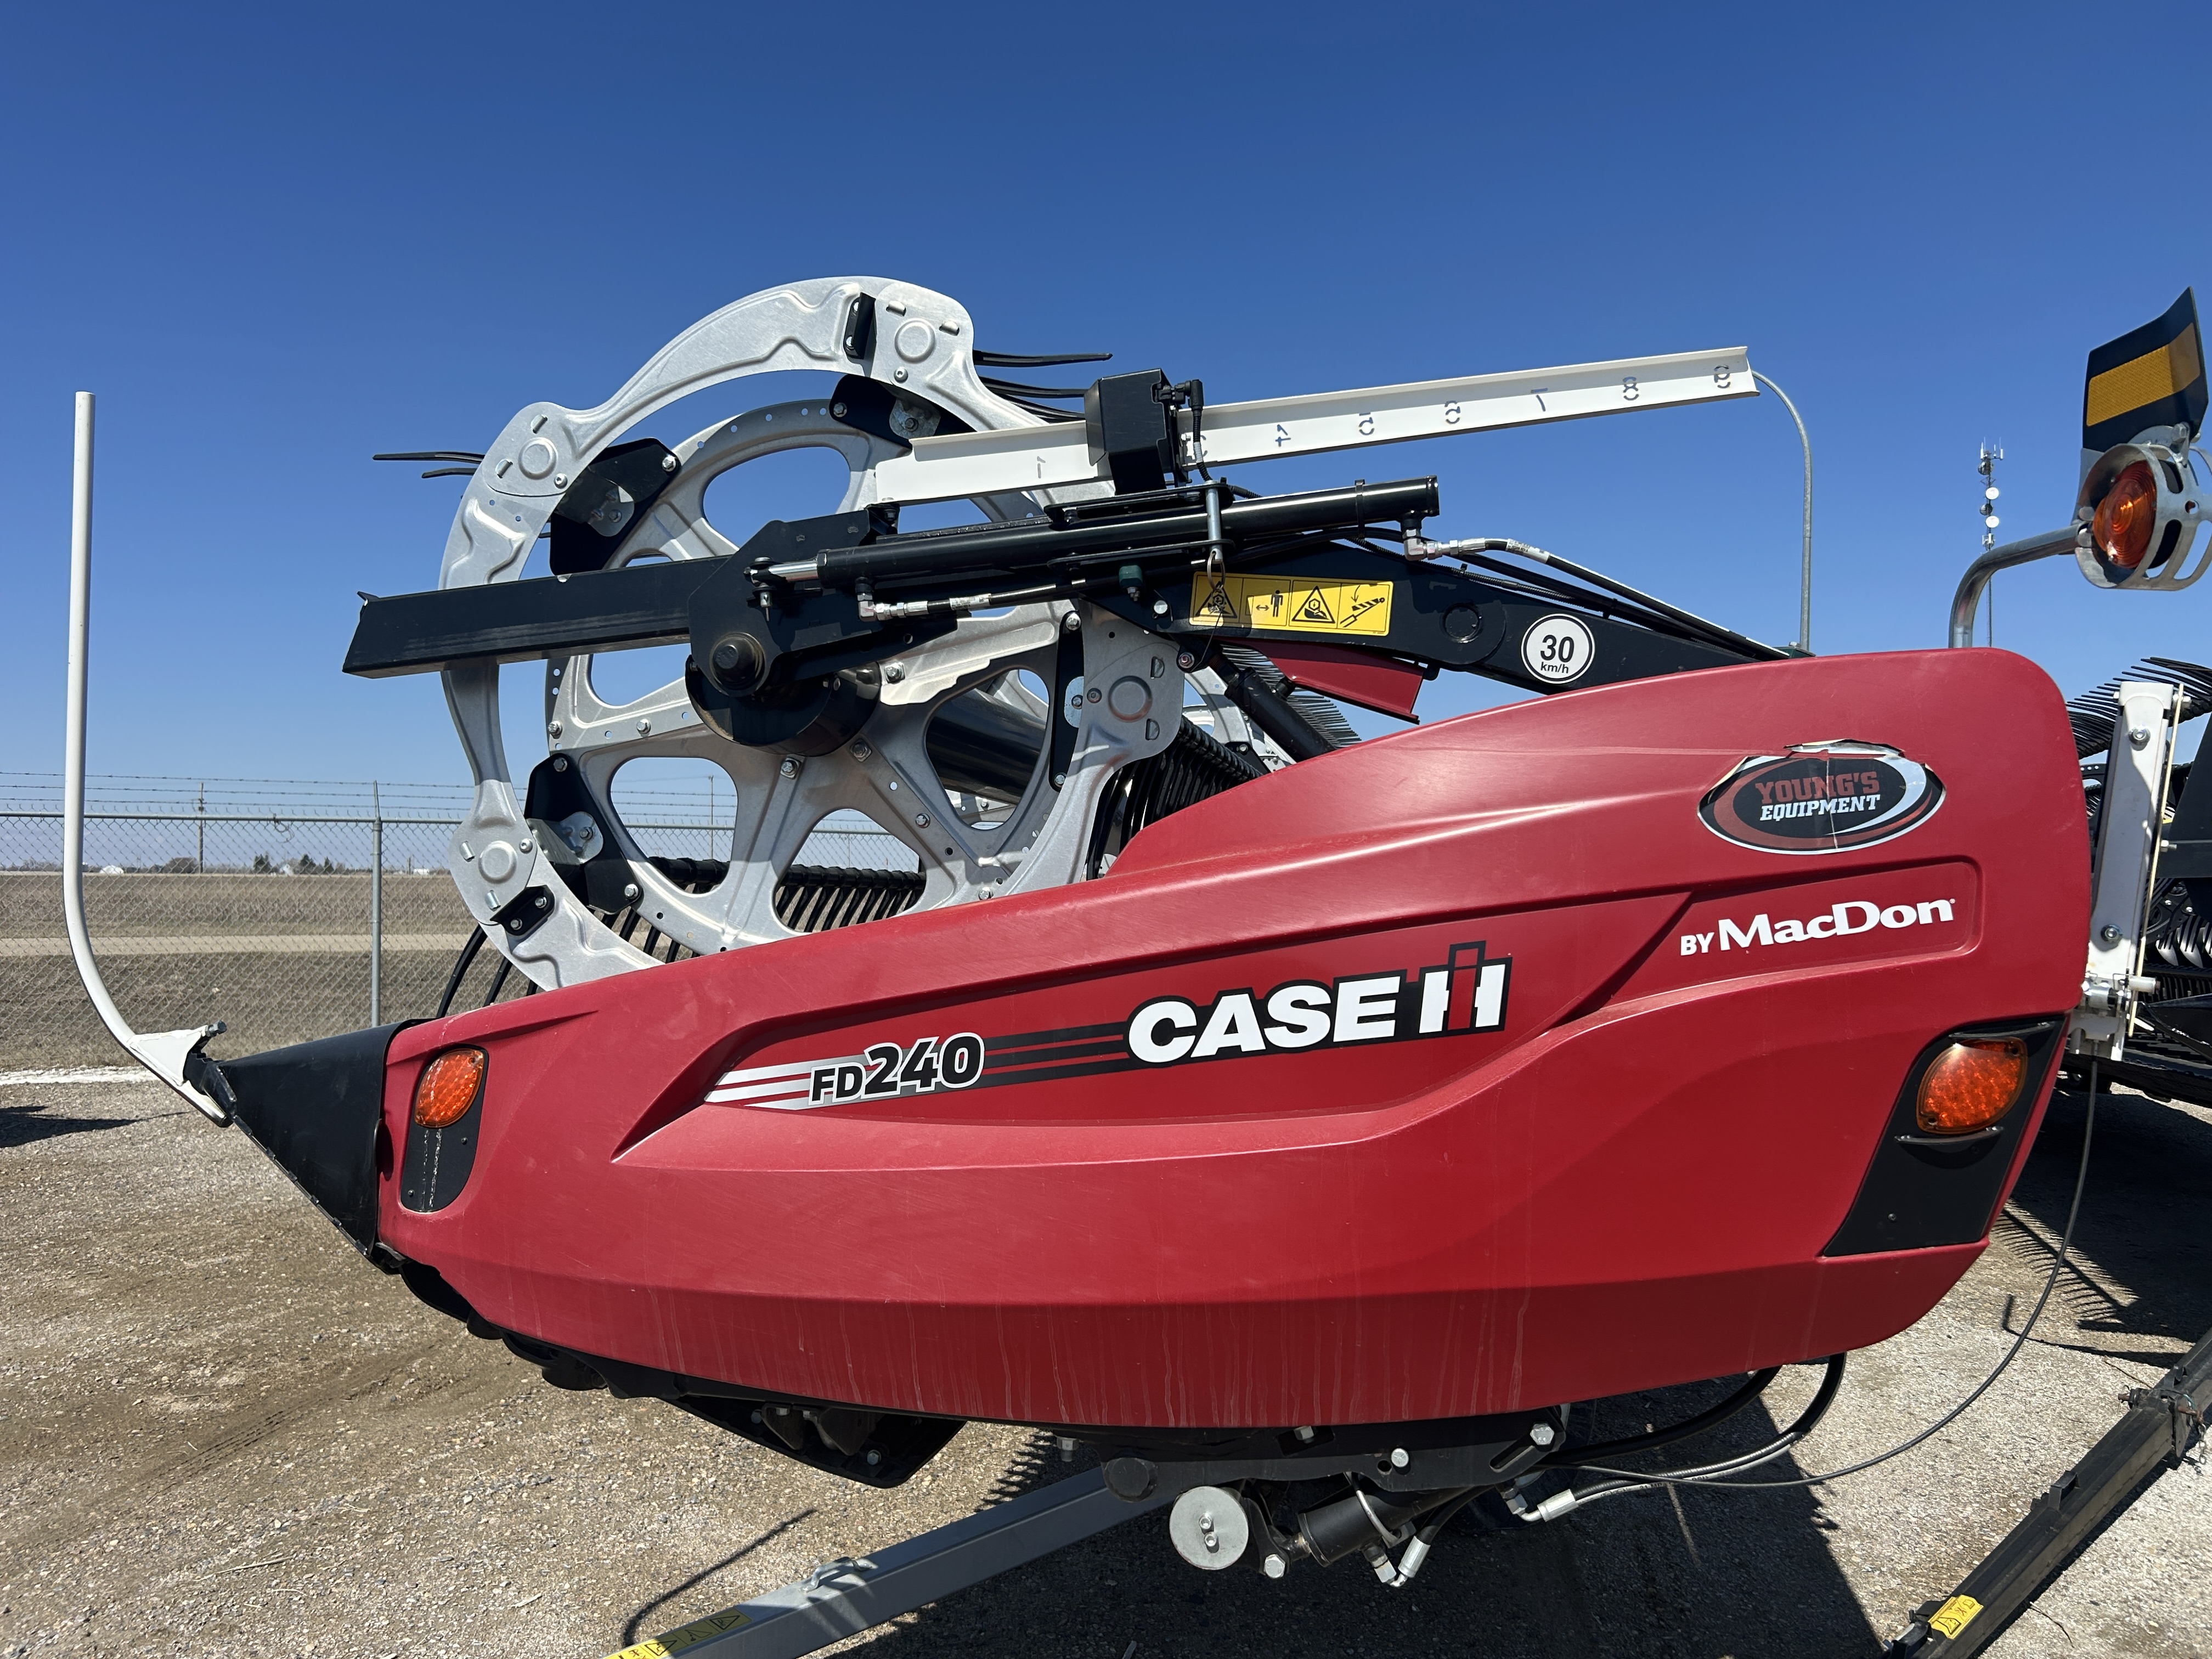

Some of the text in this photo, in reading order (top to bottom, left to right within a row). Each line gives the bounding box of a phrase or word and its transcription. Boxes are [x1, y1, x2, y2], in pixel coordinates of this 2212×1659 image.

[1540, 634, 1575, 663] 30
[1540, 661, 1569, 674] km/h
[1755, 771, 1880, 805] YOUNG'S
[1759, 794, 1881, 822] EQUIPMENT
[1680, 898, 1955, 956] BY MacDon
[1127, 940, 1507, 1064] CASE IH
[810, 1034, 983, 1104] FD240
